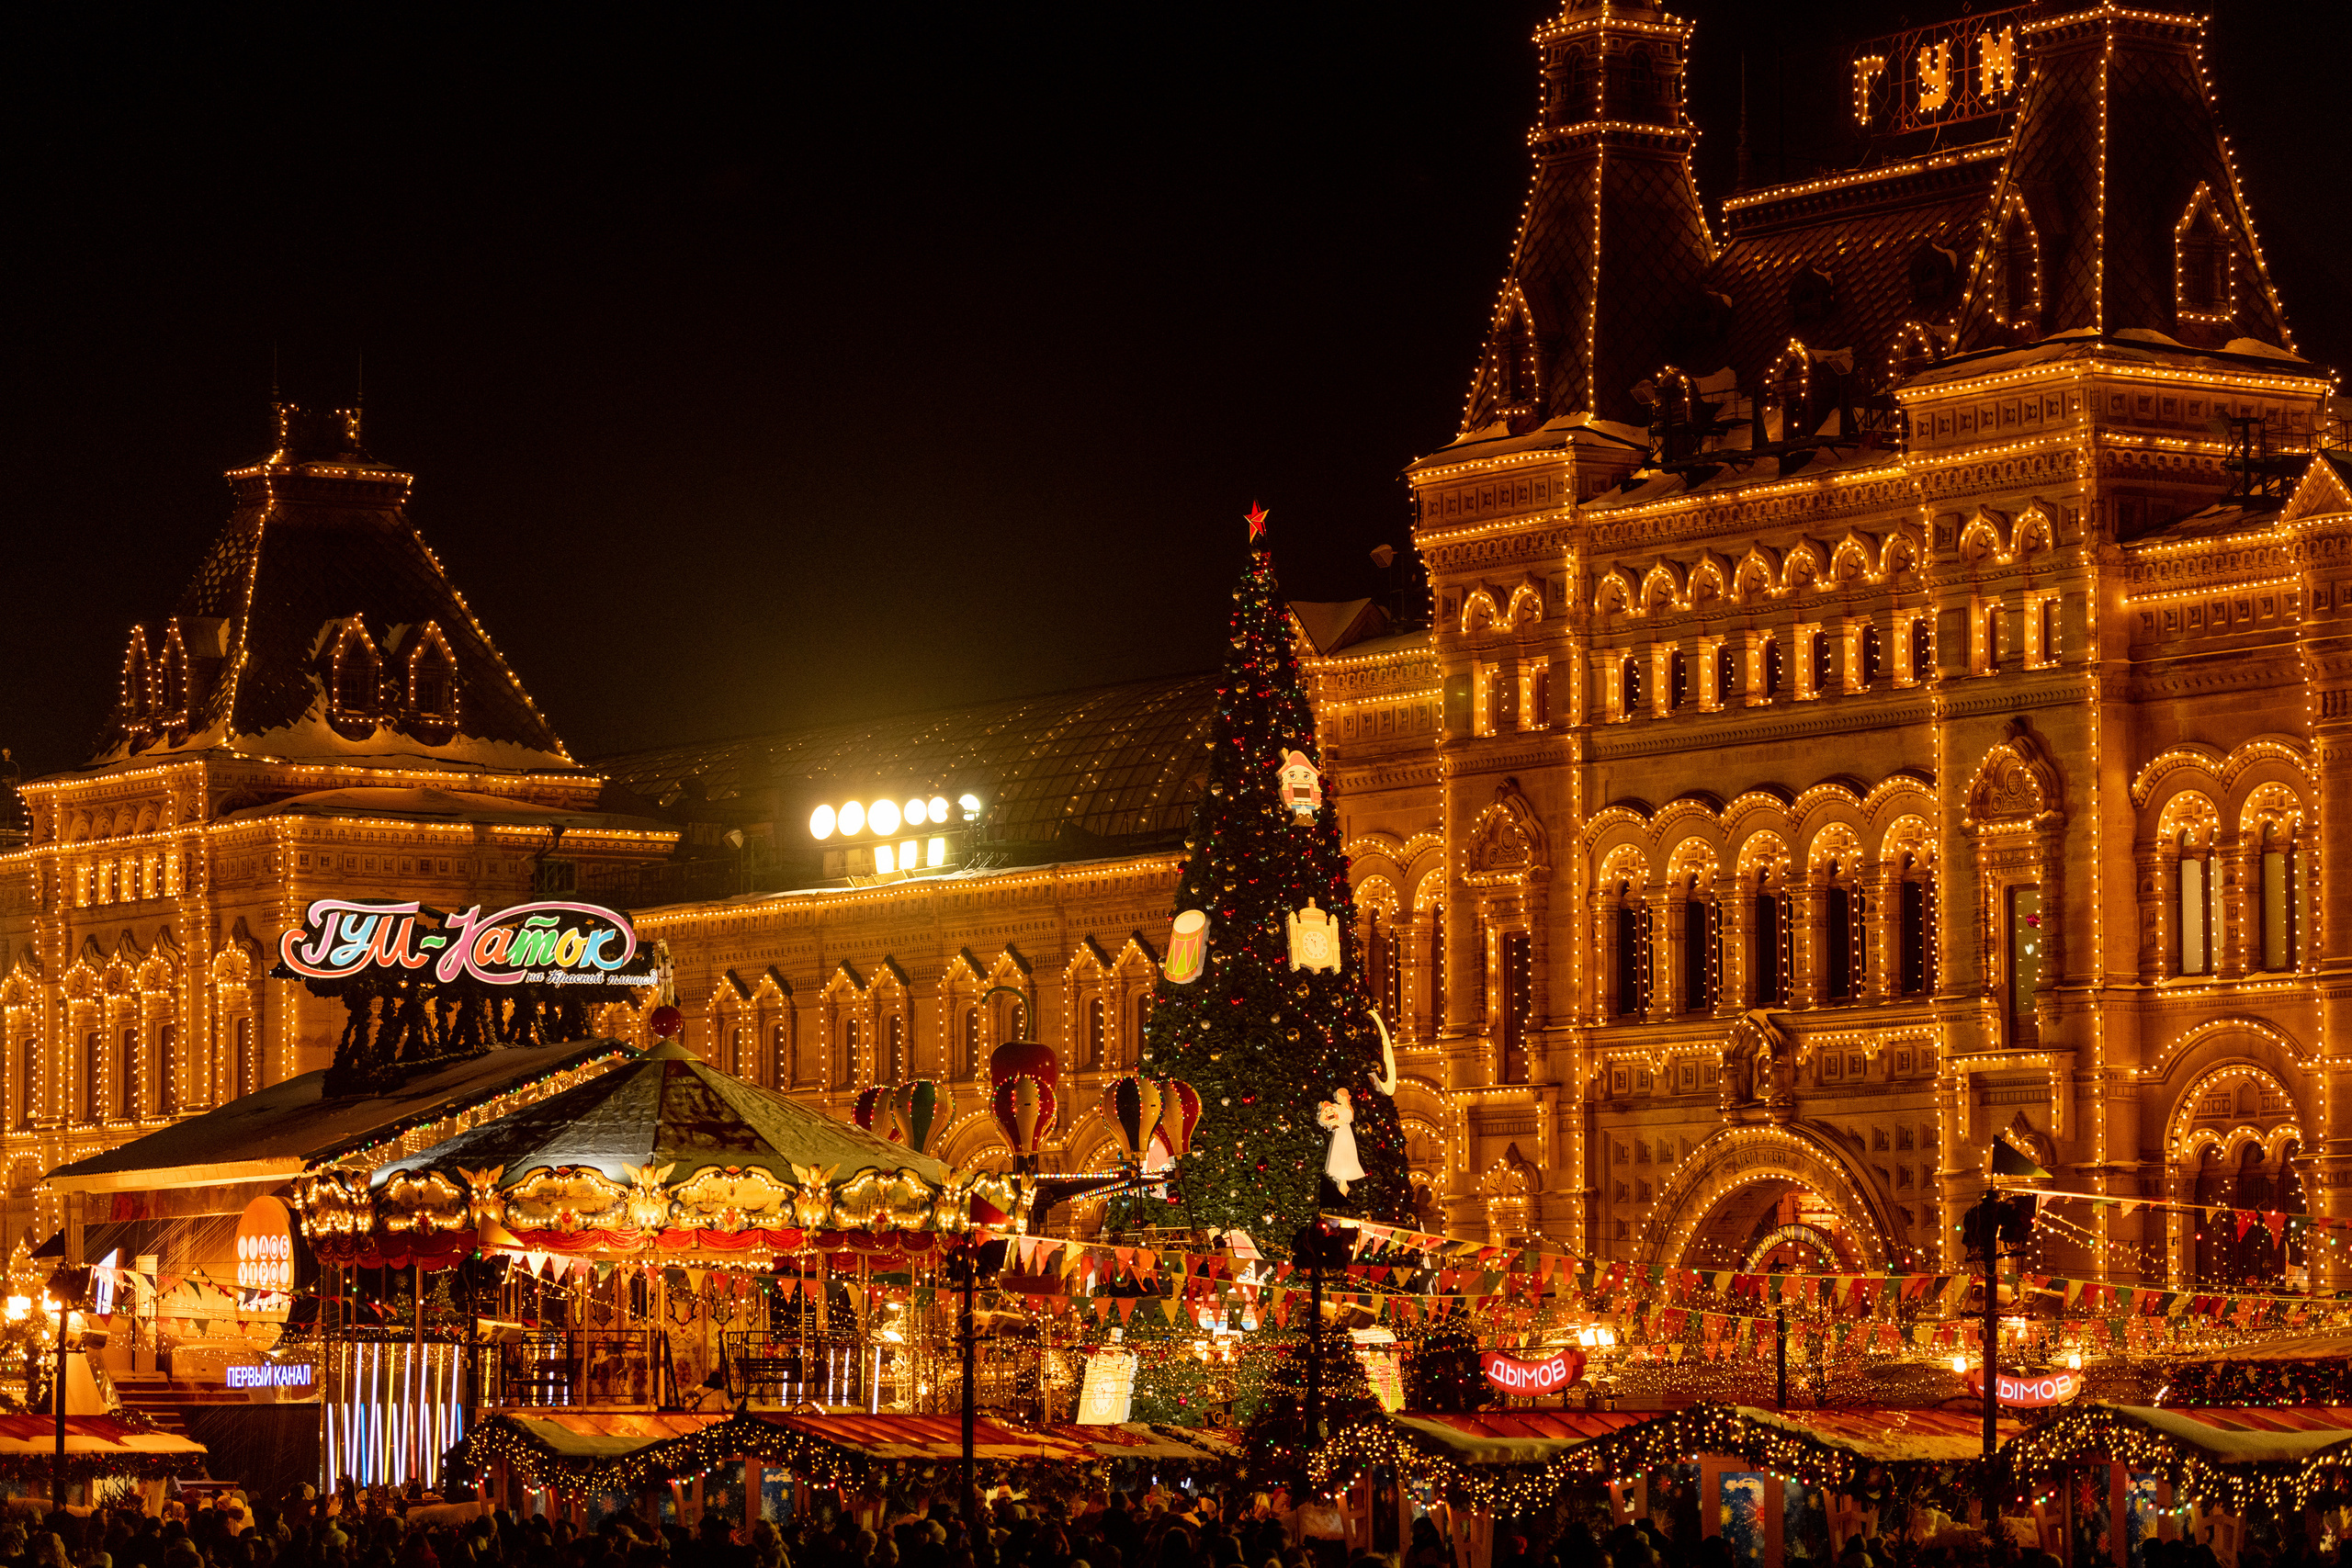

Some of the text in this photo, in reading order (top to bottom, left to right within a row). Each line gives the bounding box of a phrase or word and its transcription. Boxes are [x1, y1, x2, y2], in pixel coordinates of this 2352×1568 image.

[1853, 25, 2015, 125] ГУМ
[525, 968, 659, 988] на Красной площад
[260, 1237, 288, 1257] ДОБ
[1801, 1227, 1843, 1269] ГУО
[240, 1262, 278, 1284] УТРО
[227, 1360, 311, 1388] ПЕРВЫЙ КАНАЛ
[1488, 1359, 1566, 1388] ДЫМОВ
[1978, 1374, 2073, 1400] ЫМОВ
